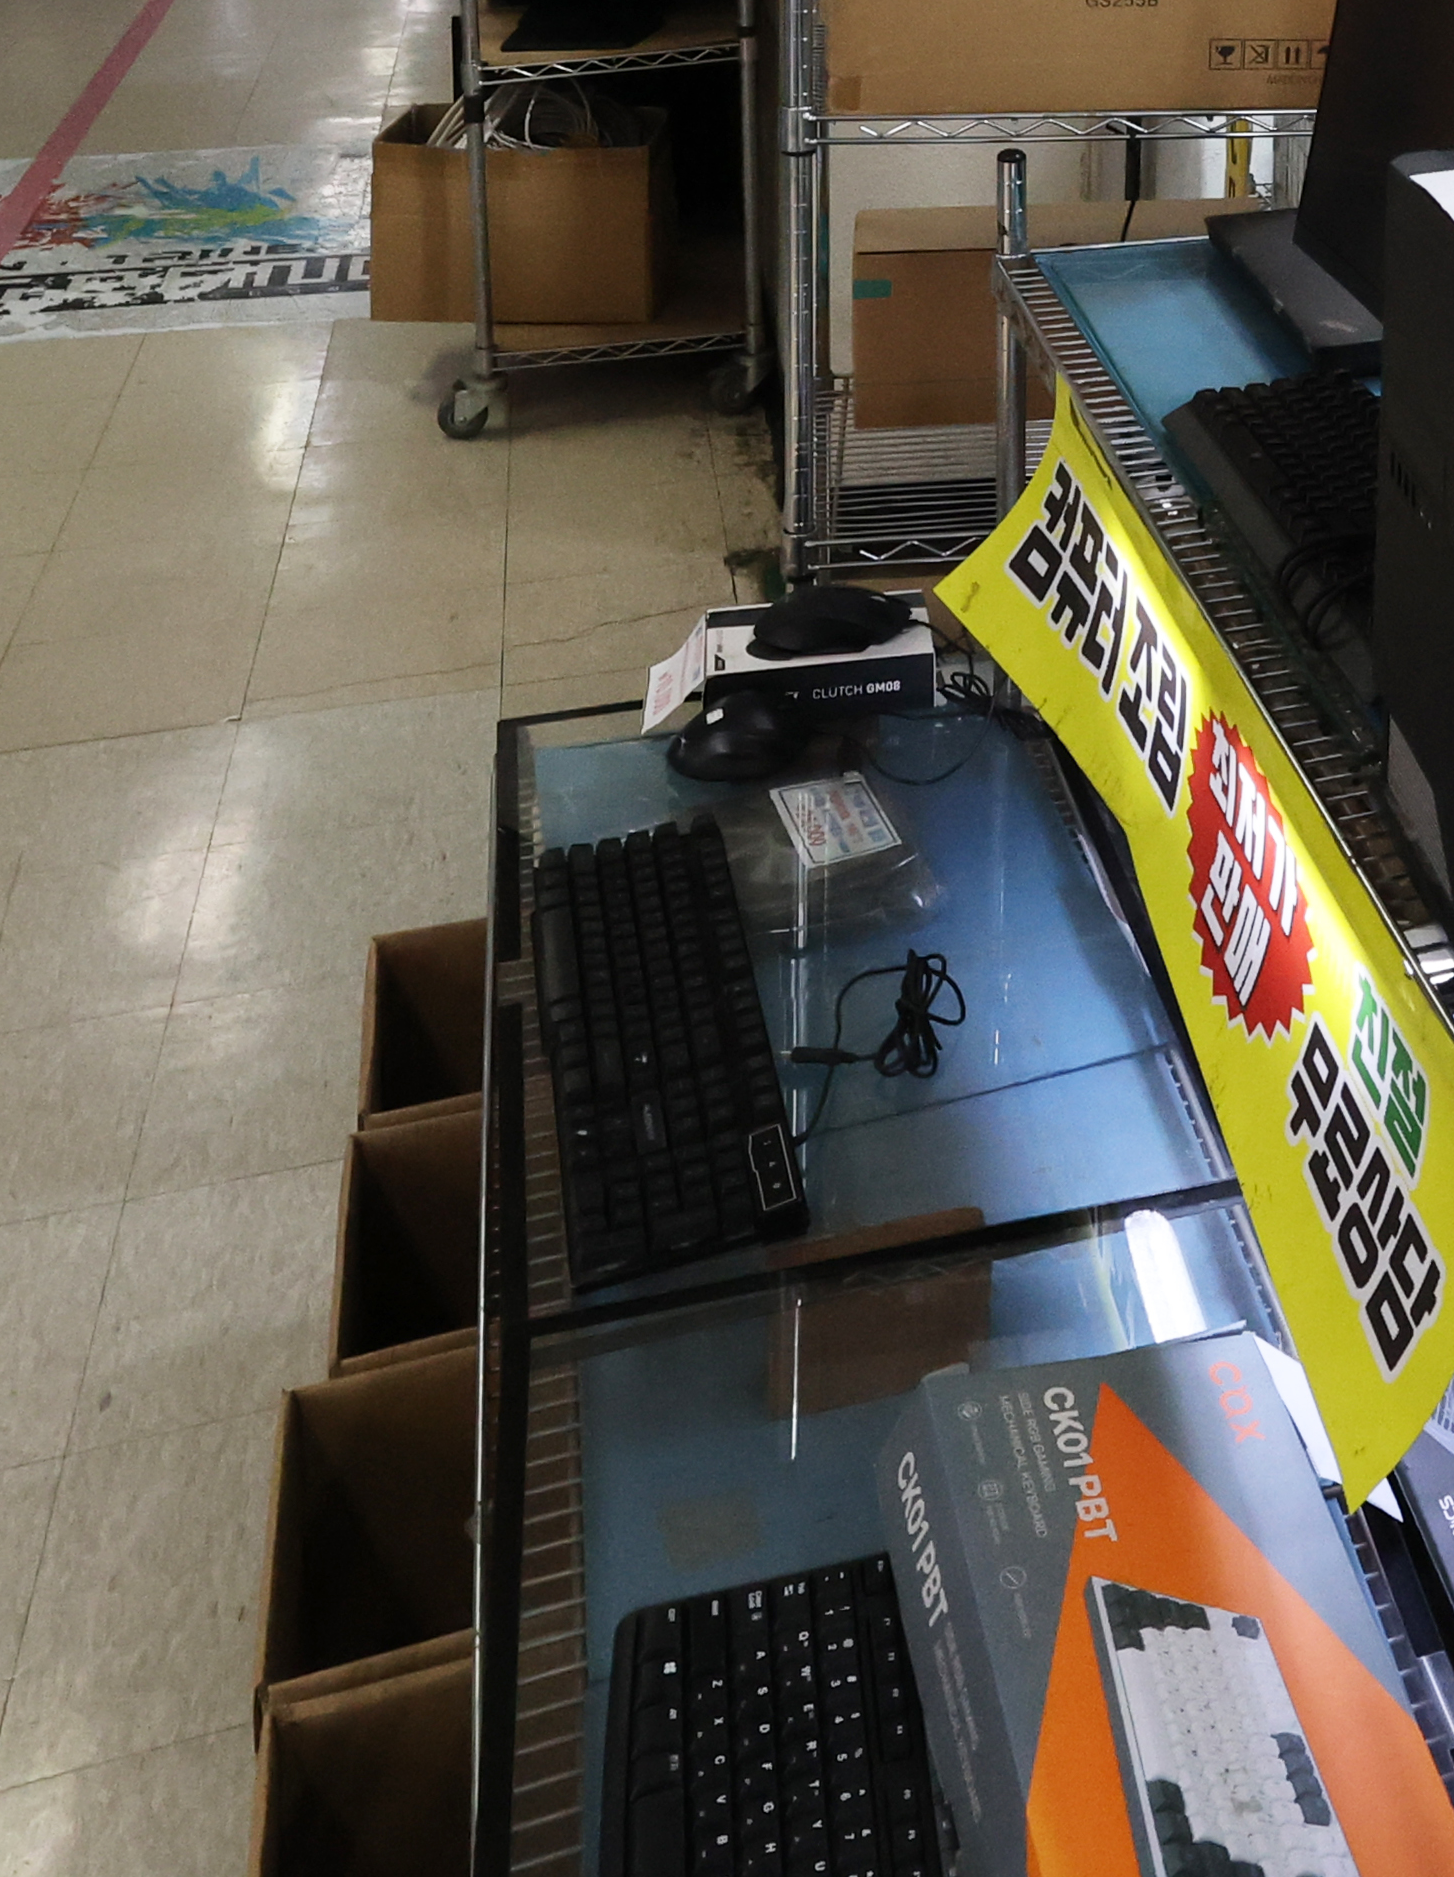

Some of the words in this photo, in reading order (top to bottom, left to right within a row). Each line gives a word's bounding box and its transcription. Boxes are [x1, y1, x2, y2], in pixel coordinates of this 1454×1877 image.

[812, 684, 863, 700] CLUTCH
[866, 680, 901, 695] GM08
[1351, 963, 1434, 1187] 친절
[1042, 1384, 1091, 1474] CK01
[1068, 1473, 1119, 1543] PBT
[1206, 1357, 1266, 1445] COX
[894, 1450, 930, 1554] CK01
[916, 1551, 949, 1628] PBT
